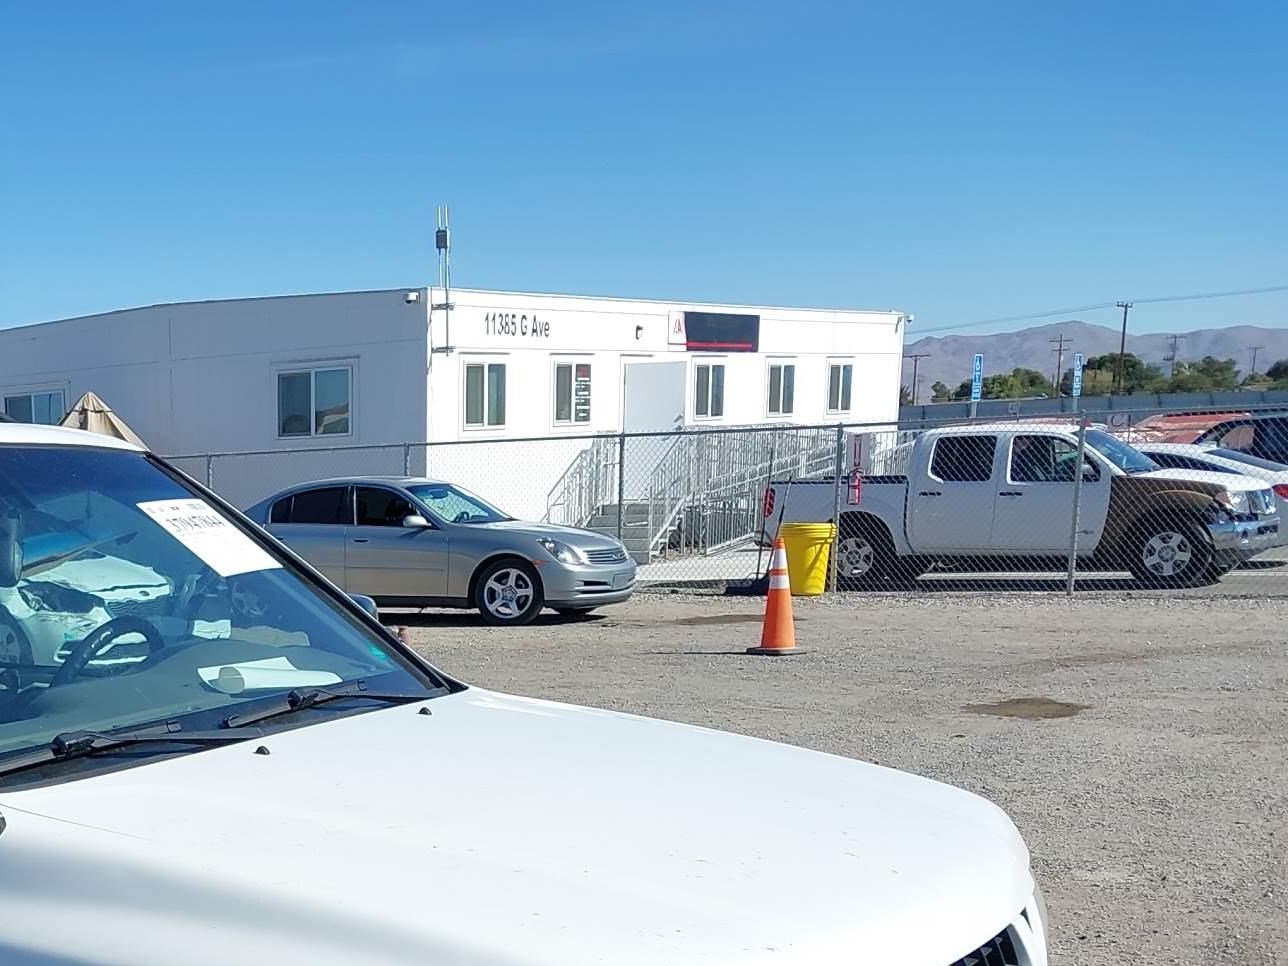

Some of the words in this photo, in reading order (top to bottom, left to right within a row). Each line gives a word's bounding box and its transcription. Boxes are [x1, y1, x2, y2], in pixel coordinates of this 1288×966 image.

[484, 312, 518, 336] 11385
[520, 314, 529, 337] G
[530, 314, 551, 338] Ave
